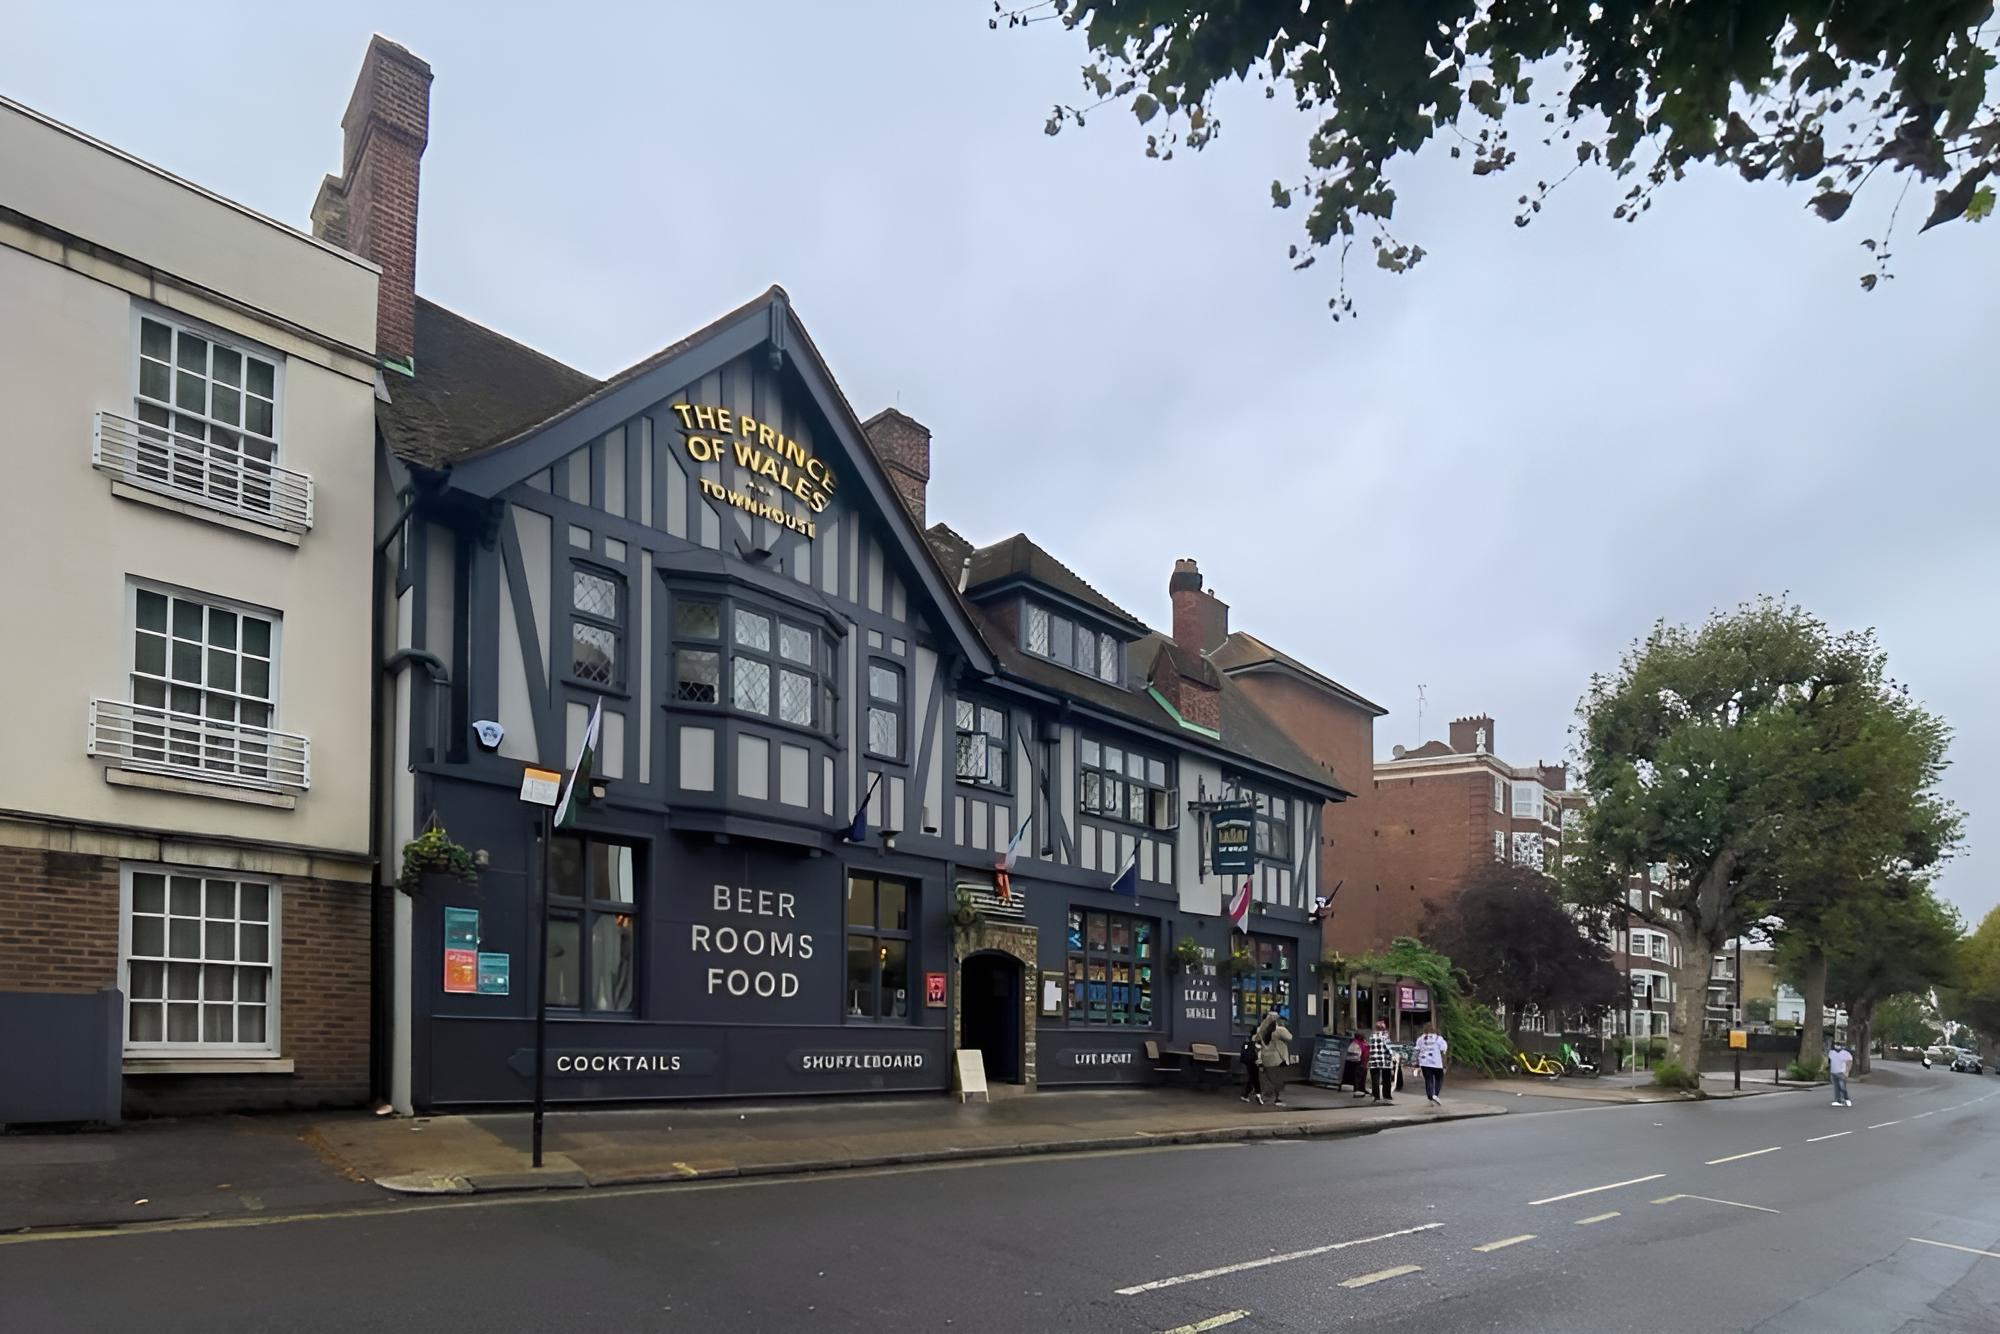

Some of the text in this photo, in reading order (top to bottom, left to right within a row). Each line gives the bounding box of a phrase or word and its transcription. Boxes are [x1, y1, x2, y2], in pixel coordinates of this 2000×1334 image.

[673, 403, 836, 494] THE PRINCE
[687, 435, 829, 513] OF WALES
[713, 884, 795, 918] BEER
[692, 924, 813, 959] ROOMS
[708, 967, 799, 997] FOOD
[557, 1055, 681, 1071] COCKTAILS
[803, 1055, 923, 1069] SHUFFLEBOARD
